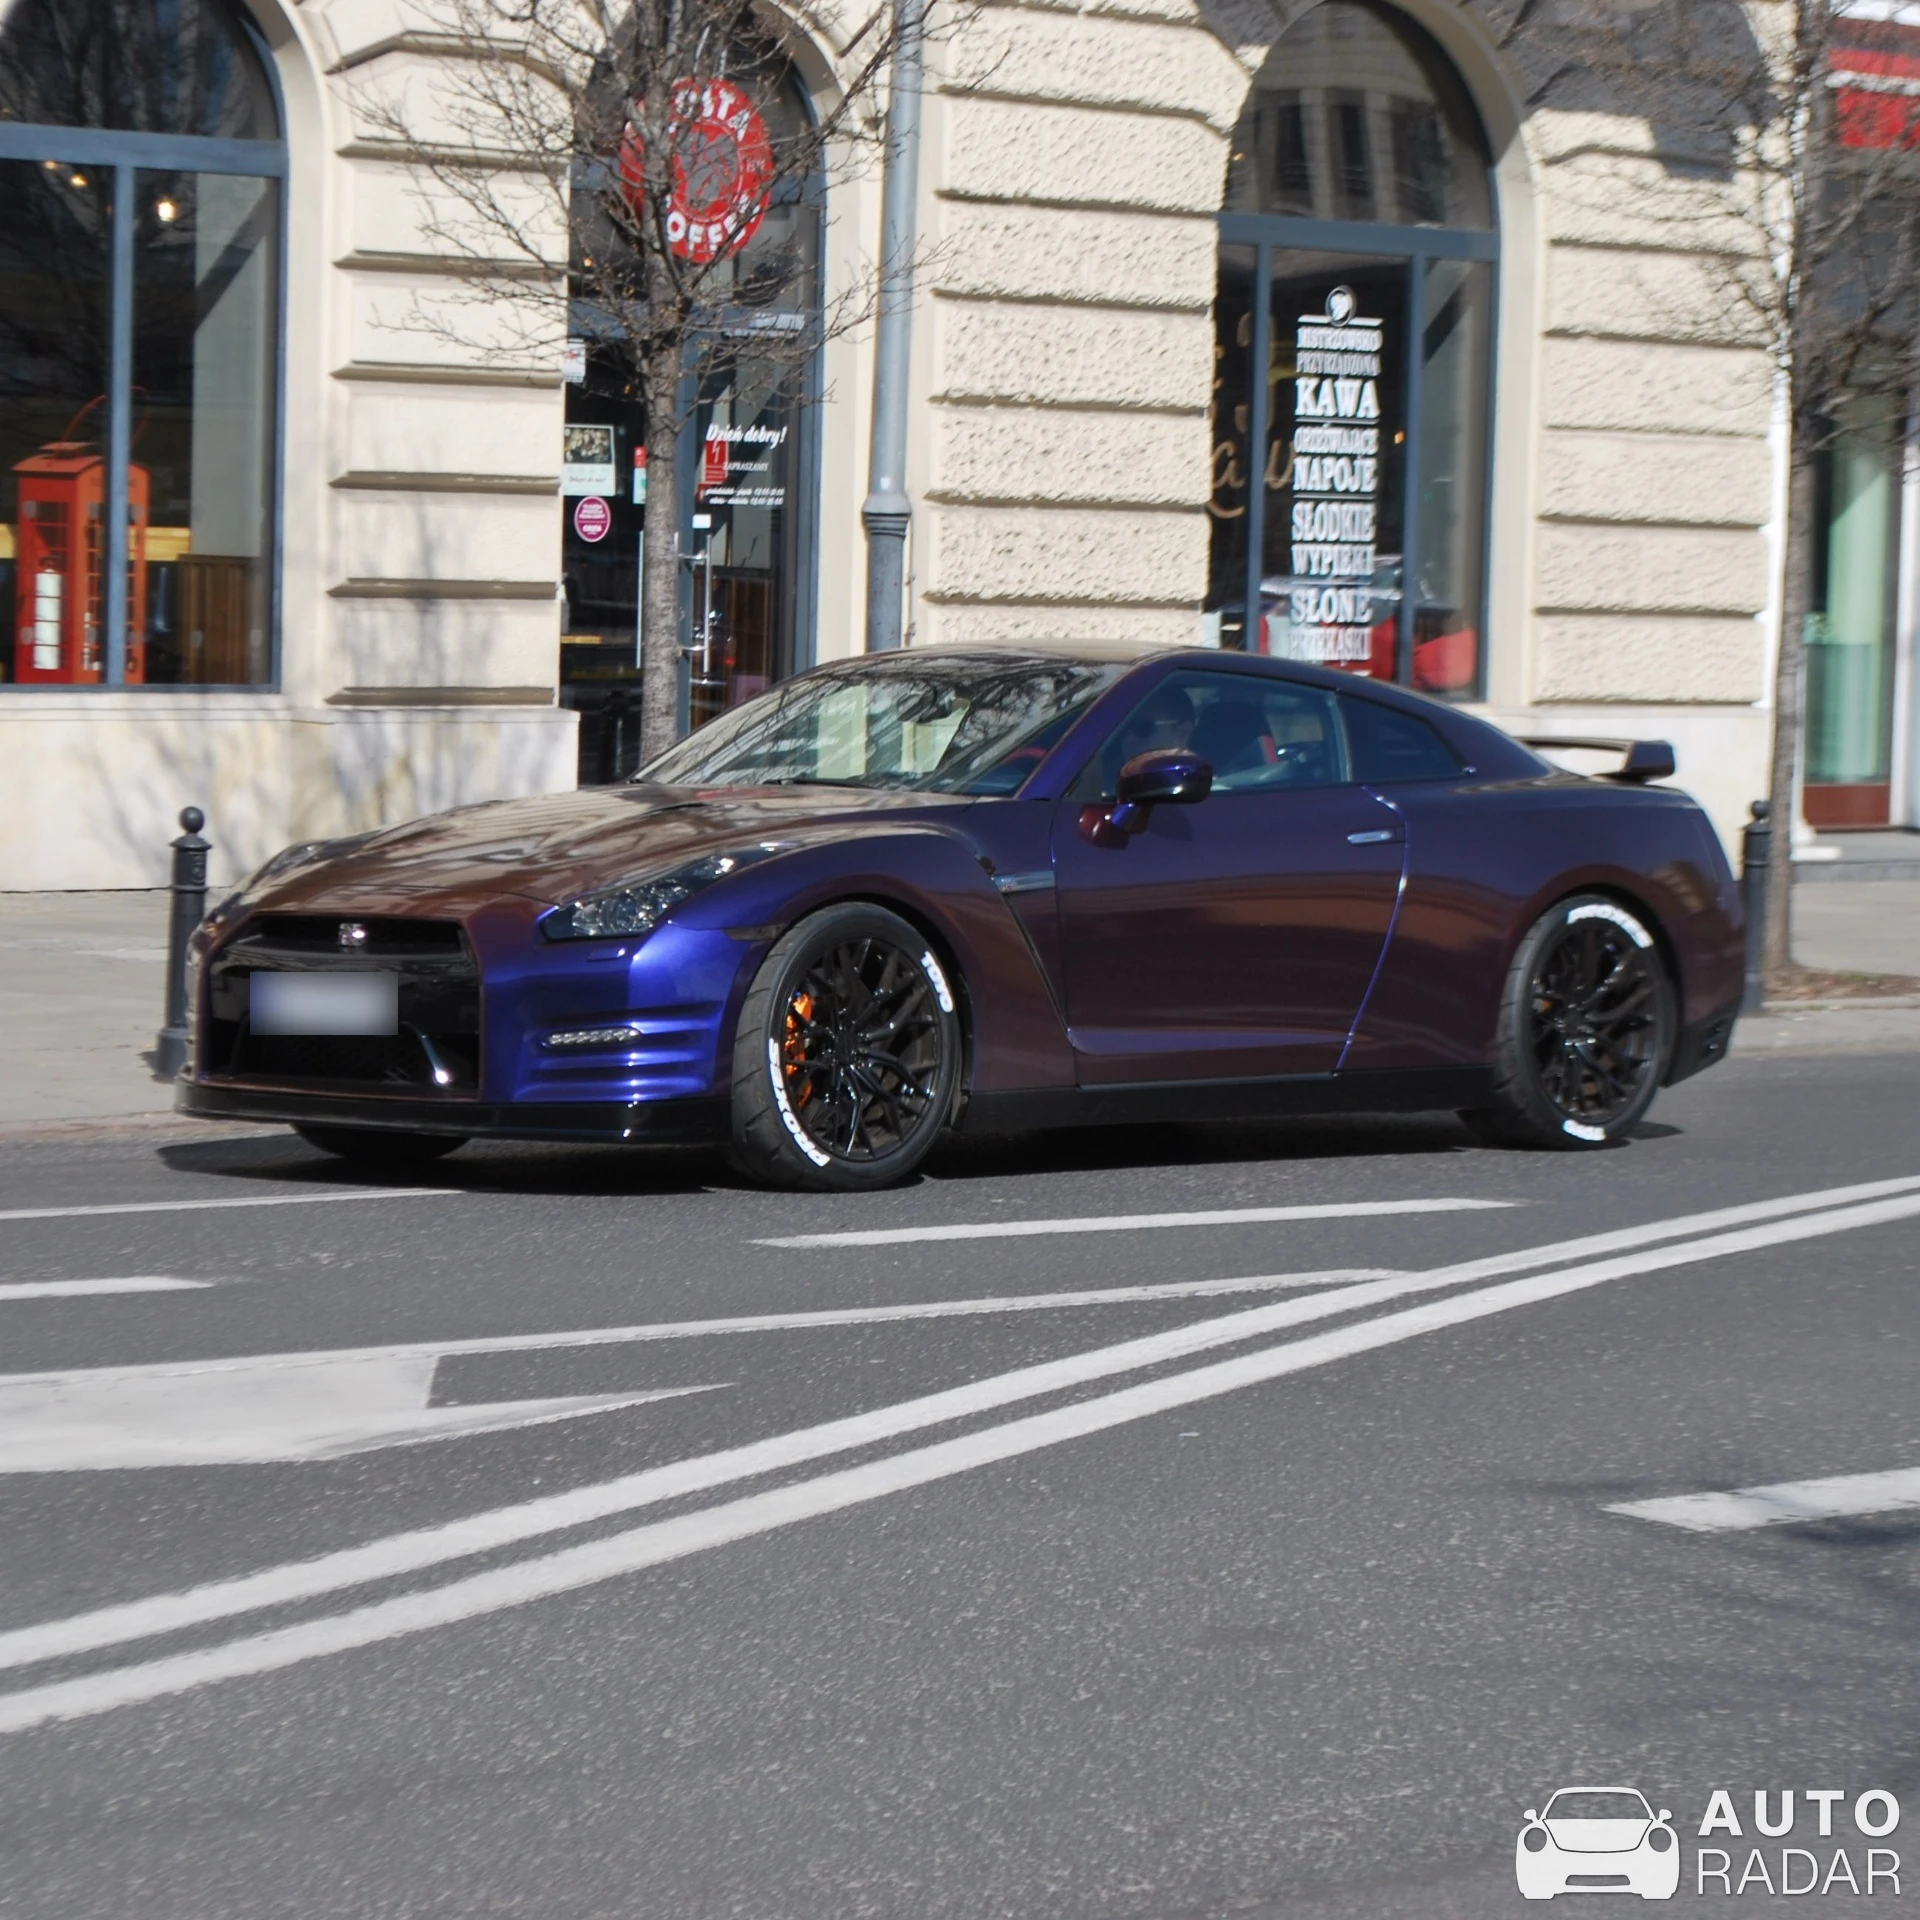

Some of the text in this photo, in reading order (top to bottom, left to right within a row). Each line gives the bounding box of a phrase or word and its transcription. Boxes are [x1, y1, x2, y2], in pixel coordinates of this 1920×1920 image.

[666, 193, 760, 251] OFFEE
[1295, 377, 1380, 418] KAWA
[743, 424, 787, 450] dobry!
[1293, 456, 1378, 492] NAPOJE
[1292, 501, 1376, 542] SŁODKIE
[1291, 543, 1376, 576] WYPIEKI
[1291, 587, 1374, 624] SŁONE
[920, 951, 953, 1013] TOYO
[769, 1037, 830, 1167] PROXES
